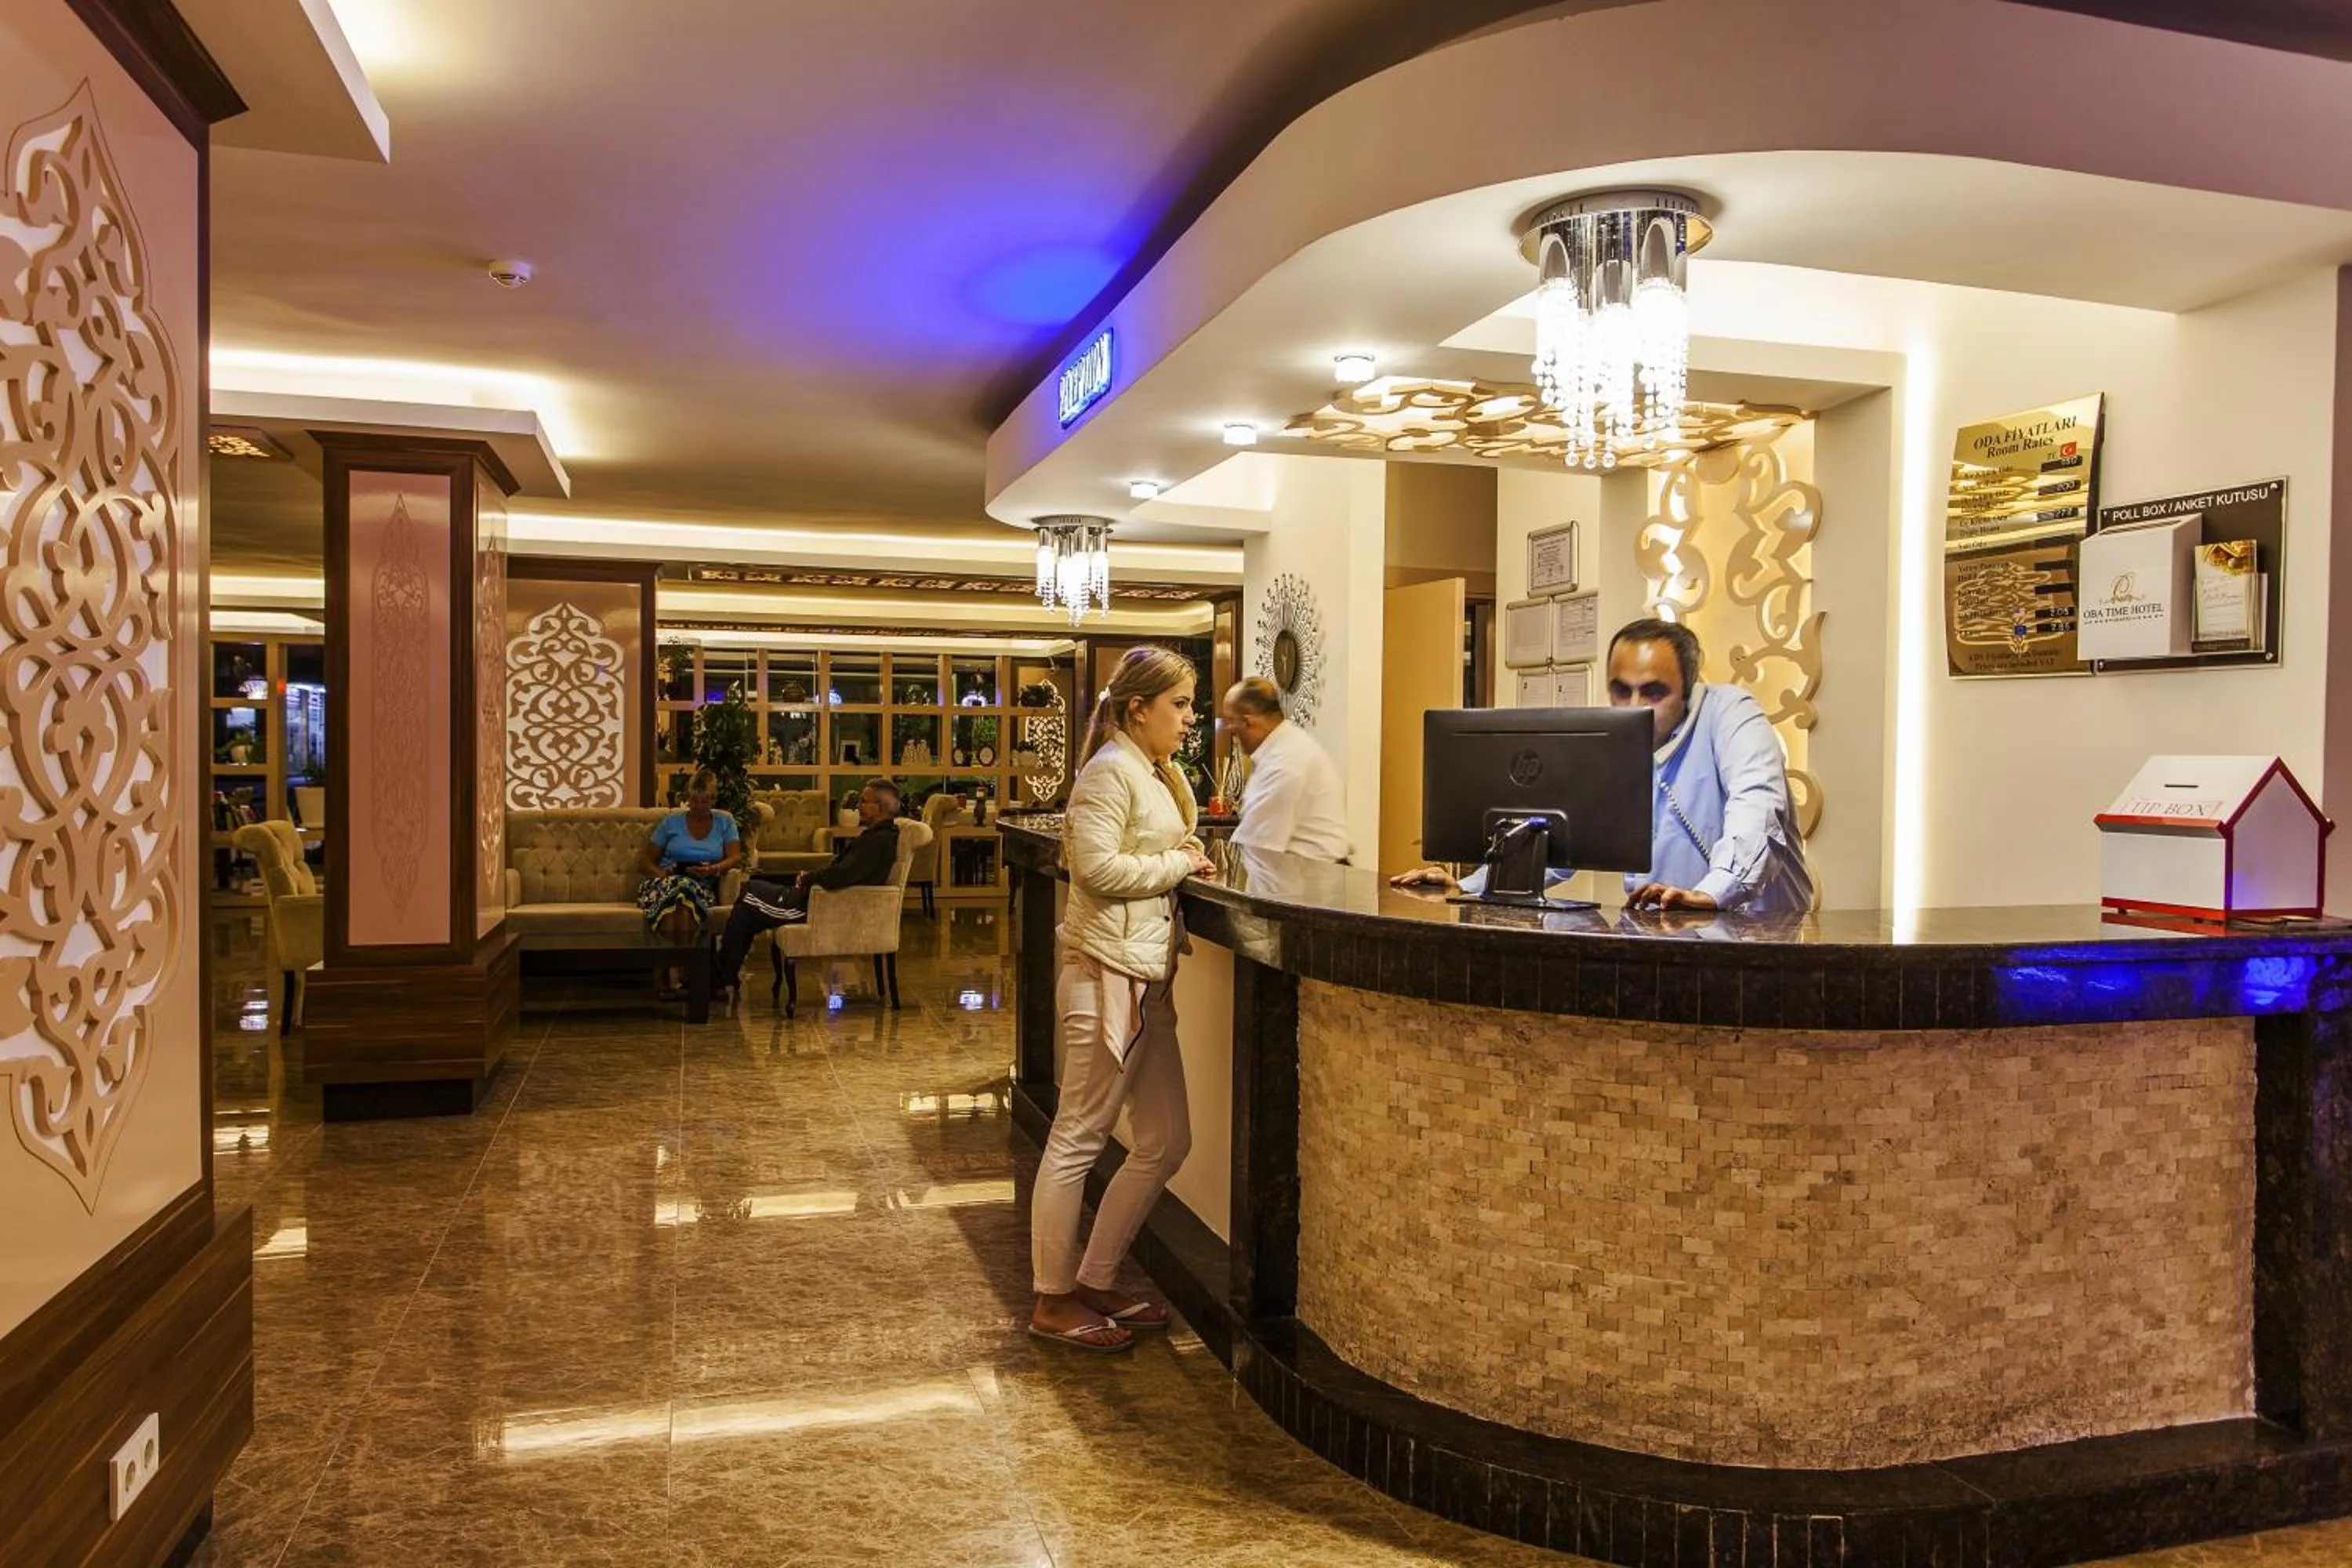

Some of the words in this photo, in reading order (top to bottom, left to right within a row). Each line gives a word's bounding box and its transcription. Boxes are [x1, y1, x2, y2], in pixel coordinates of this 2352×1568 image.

[1973, 434, 2002, 450] ODA
[1987, 445, 2020, 458] Room
[2022, 436, 2054, 451] Rates
[2113, 508, 2141, 521] POLL
[2142, 505, 2167, 517] BOX
[2174, 495, 2213, 513] ANKET
[2216, 487, 2269, 506] KUTUSU
[2083, 609, 2103, 619] OBA
[2105, 605, 2129, 617] TIME
[2131, 603, 2164, 615] HOTEL
[2130, 801, 2161, 814] TIP
[2164, 802, 2207, 816] BOX
